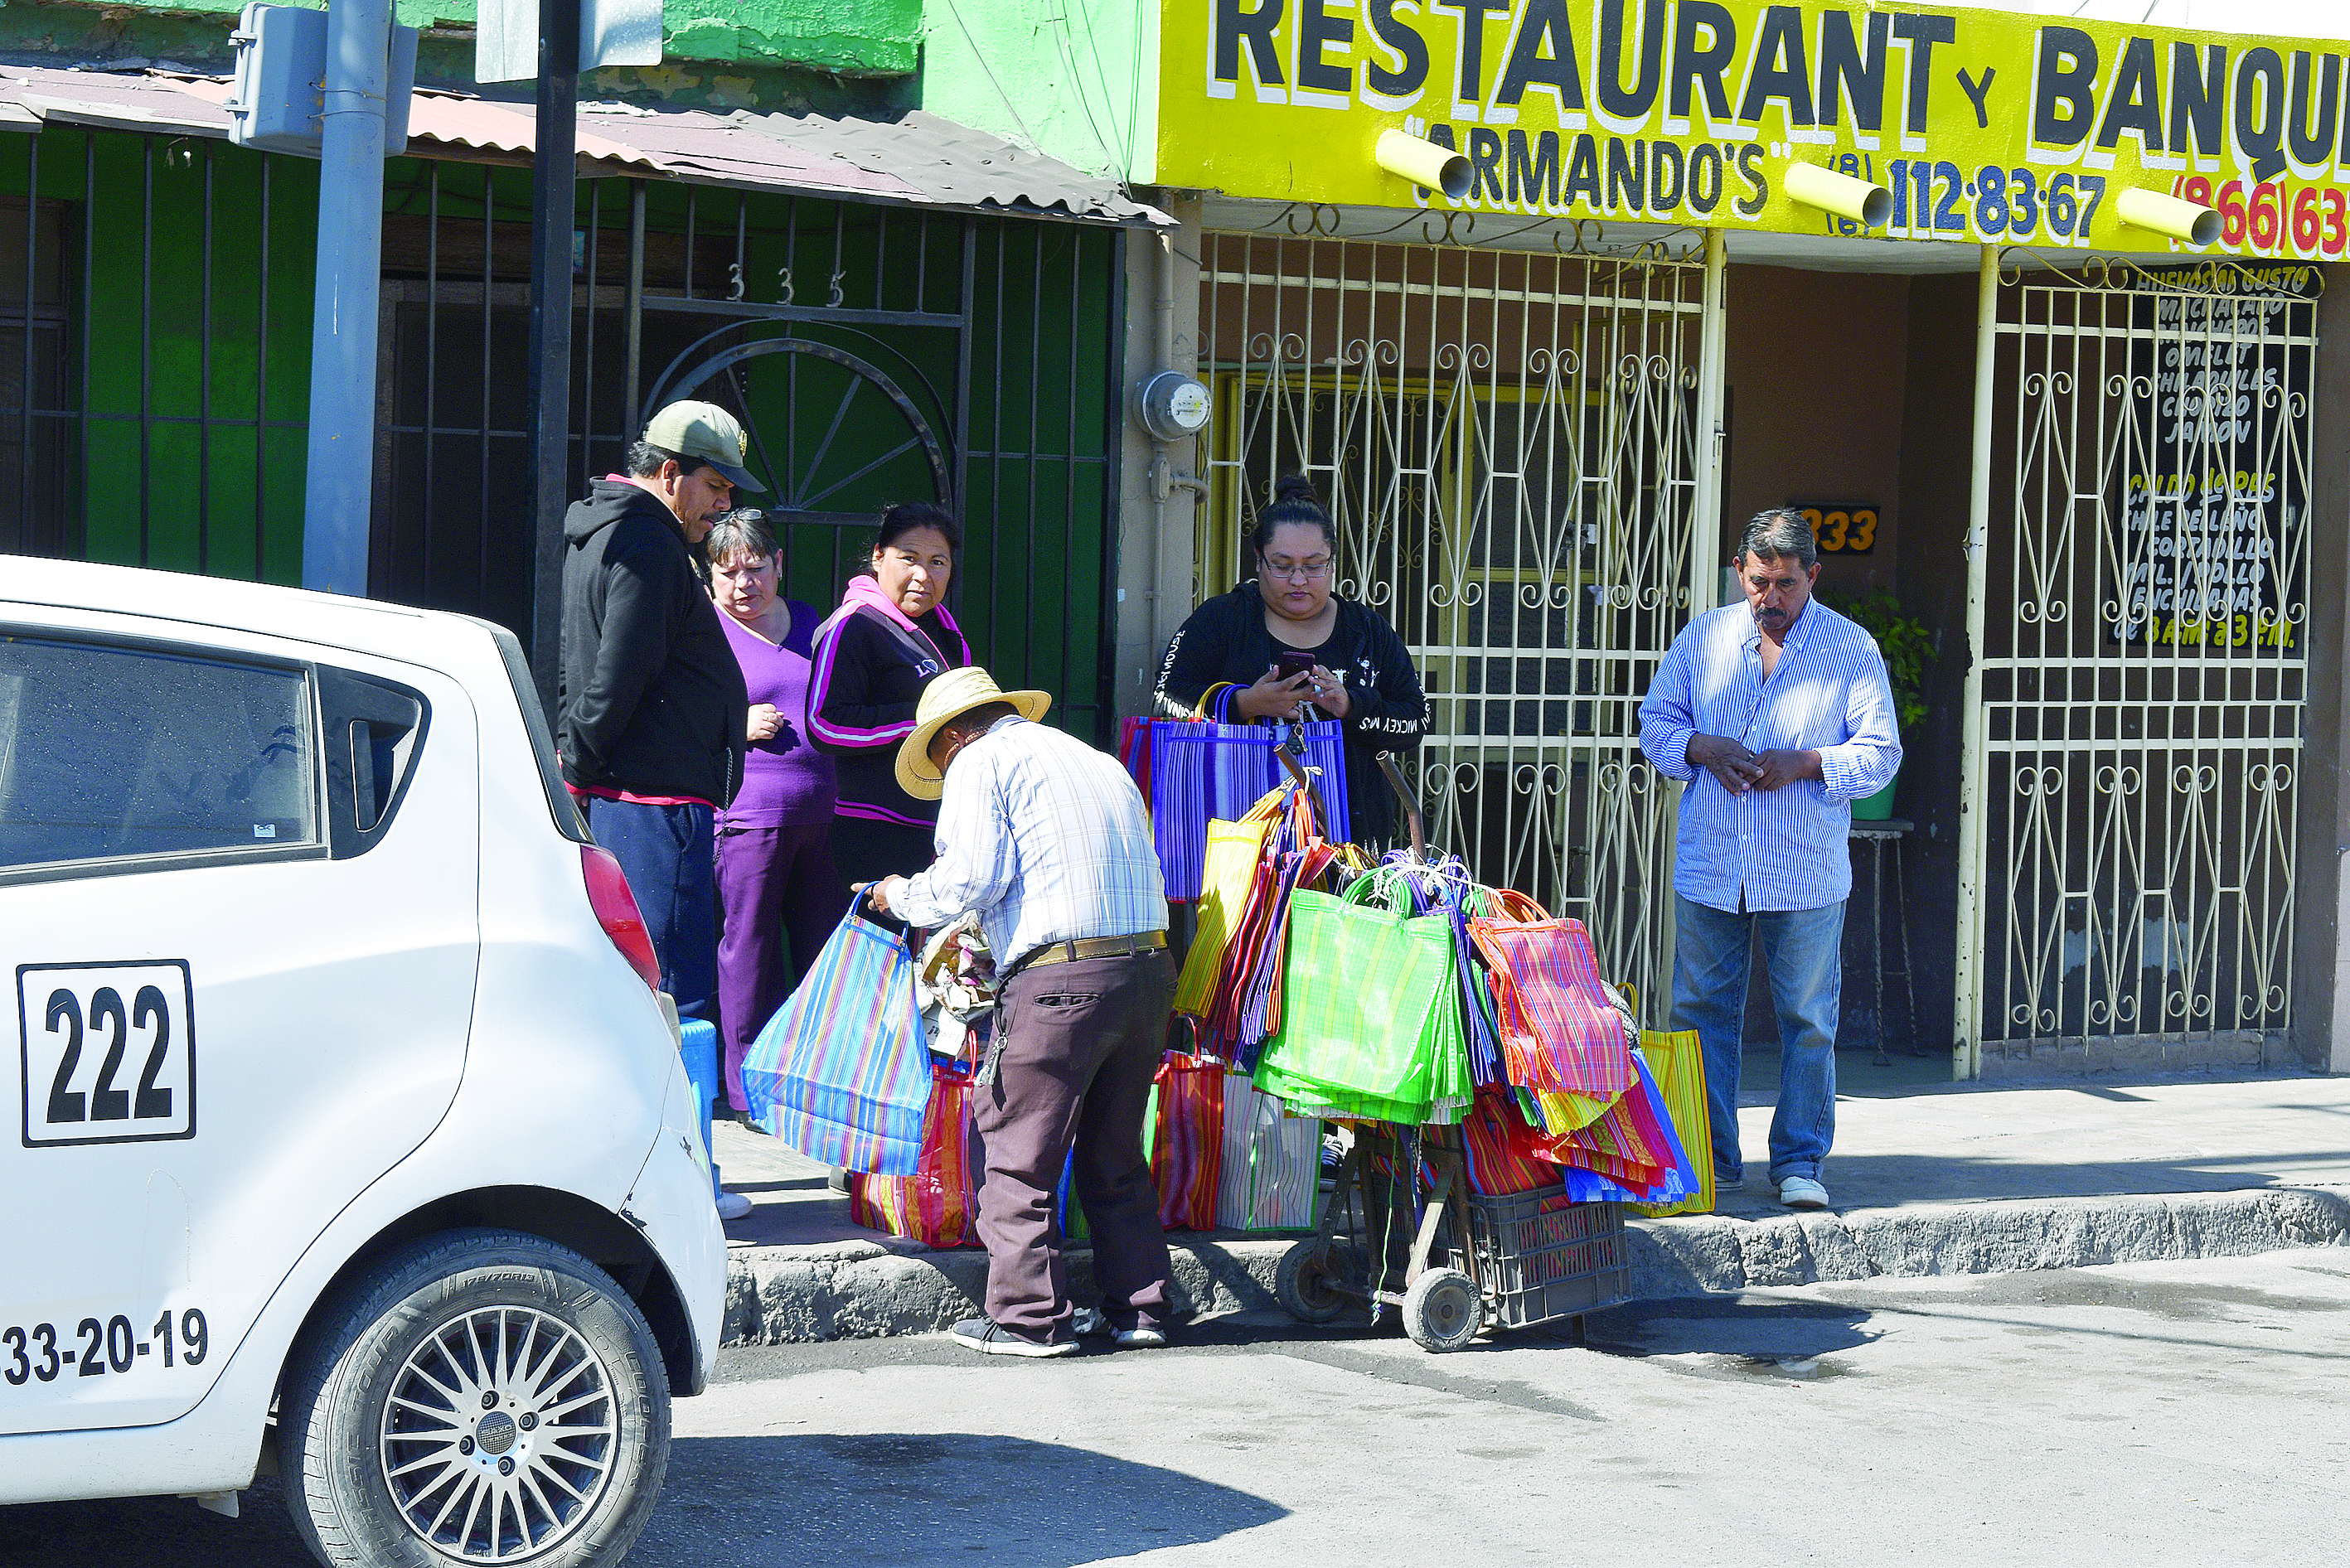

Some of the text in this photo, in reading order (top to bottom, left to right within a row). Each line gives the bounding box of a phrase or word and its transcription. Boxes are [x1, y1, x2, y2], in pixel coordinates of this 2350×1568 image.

[1209, 0, 1955, 149] RESTAURANT
[2026, 26, 2350, 183] BANQU
[726, 263, 847, 308] 335
[2242, 266, 2309, 293] GUSTO
[2232, 614, 2248, 646] 3
[46, 985, 172, 1124] 222
[2, 1308, 208, 1386] 33-20-19
